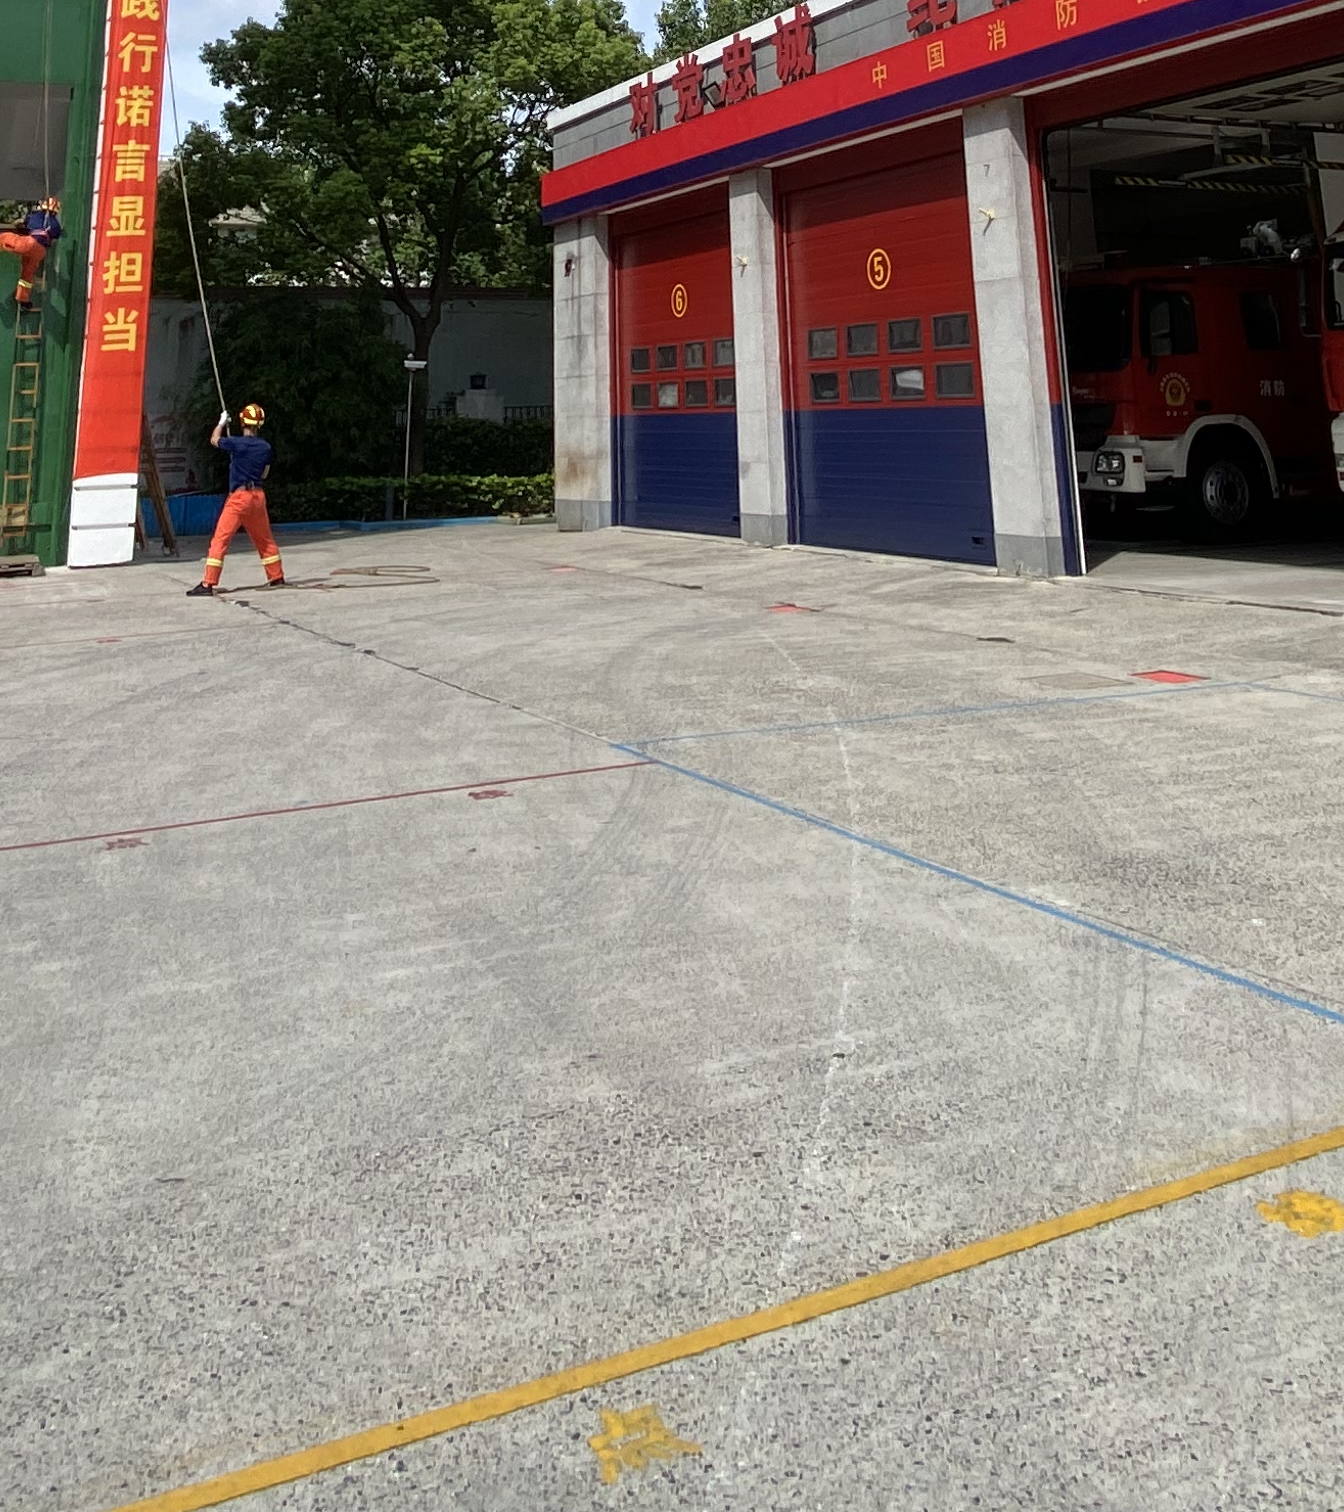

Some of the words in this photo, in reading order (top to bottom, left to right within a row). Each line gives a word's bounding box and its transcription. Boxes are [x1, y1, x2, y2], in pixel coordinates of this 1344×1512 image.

[629, 3, 814, 136] 对党忠诚
[1259, 379, 1285, 397] 消防
